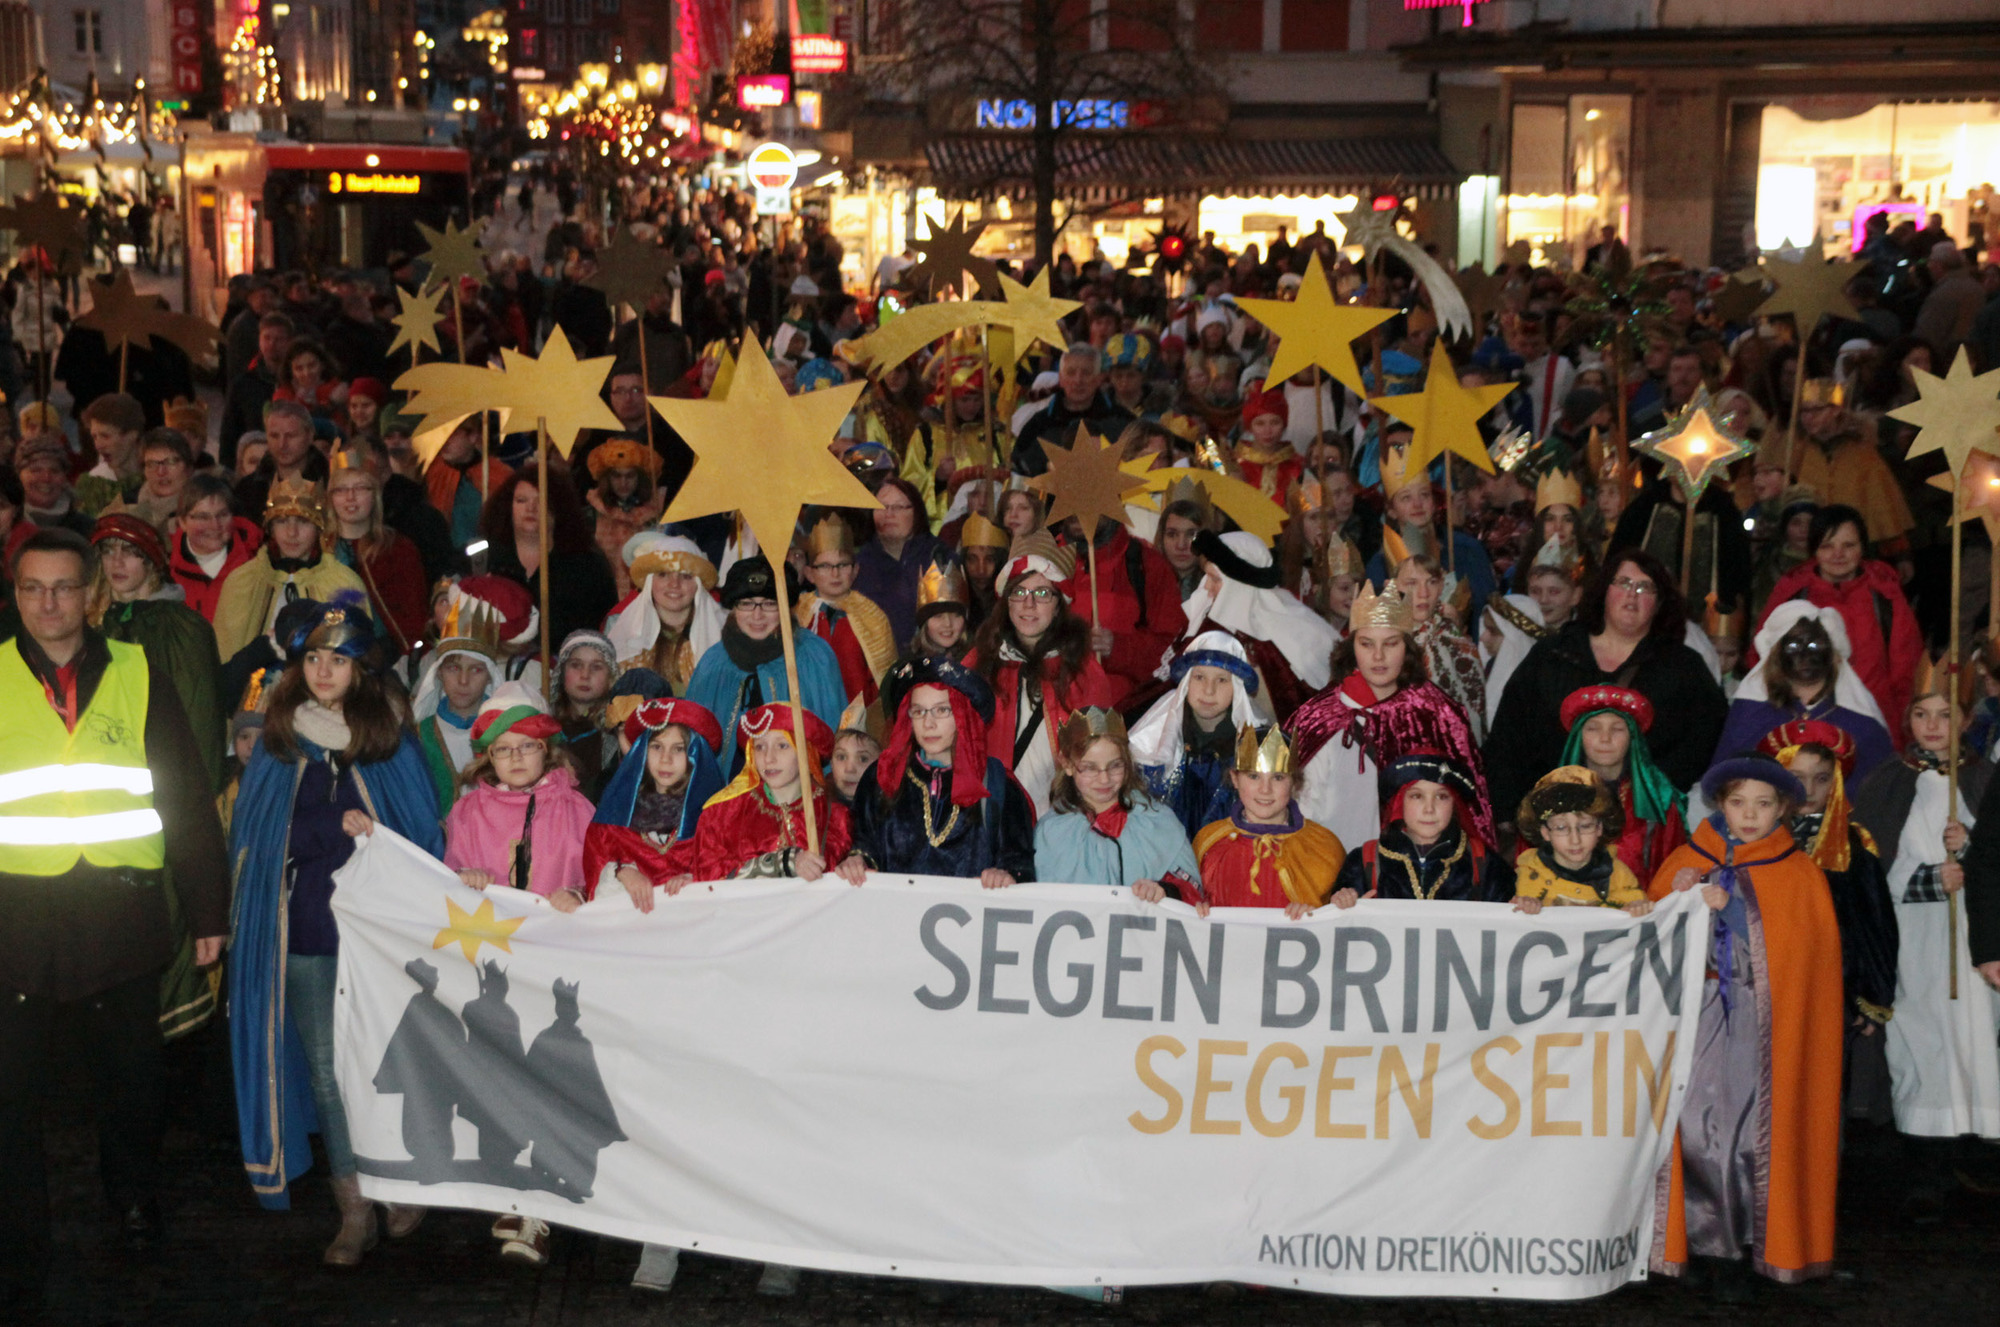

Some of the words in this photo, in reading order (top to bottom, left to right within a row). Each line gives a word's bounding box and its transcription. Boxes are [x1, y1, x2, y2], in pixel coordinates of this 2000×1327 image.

[976, 98, 1128, 129] NODSEE
[913, 903, 1225, 1025] SEGEN
[1260, 912, 1689, 1034] BRINGEN
[1127, 1034, 1441, 1140] SEGEN
[1466, 1029, 1677, 1140] SEIN
[1258, 1233, 1366, 1271] AKTION
